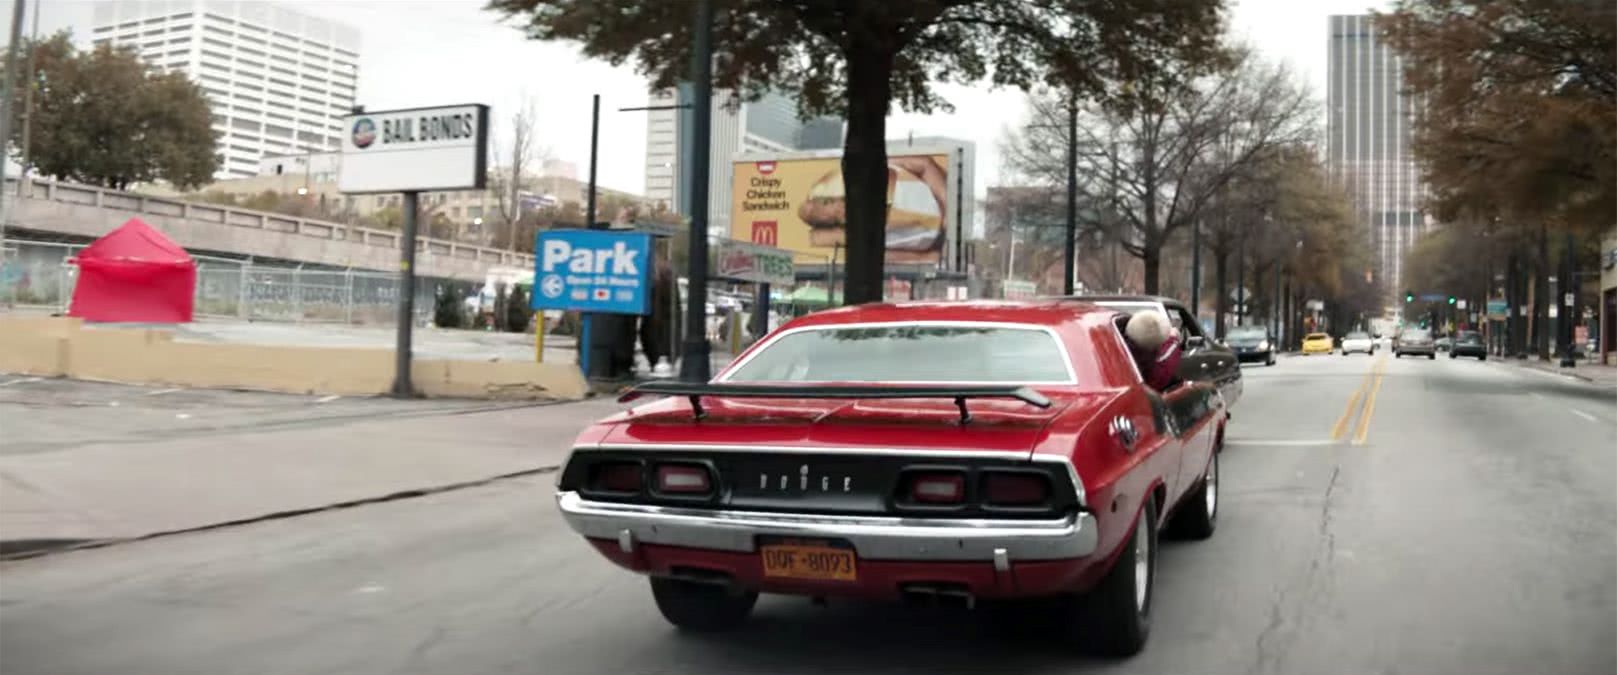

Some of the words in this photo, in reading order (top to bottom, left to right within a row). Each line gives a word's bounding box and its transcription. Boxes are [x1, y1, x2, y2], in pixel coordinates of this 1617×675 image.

[382, 118, 415, 144] BAIL
[420, 113, 473, 141] BONDS
[750, 177, 782, 189] Crispy
[745, 189, 786, 200] Chicken
[742, 200, 789, 211] Sandwich
[542, 239, 639, 275] Park
[760, 473, 851, 492] DODGE
